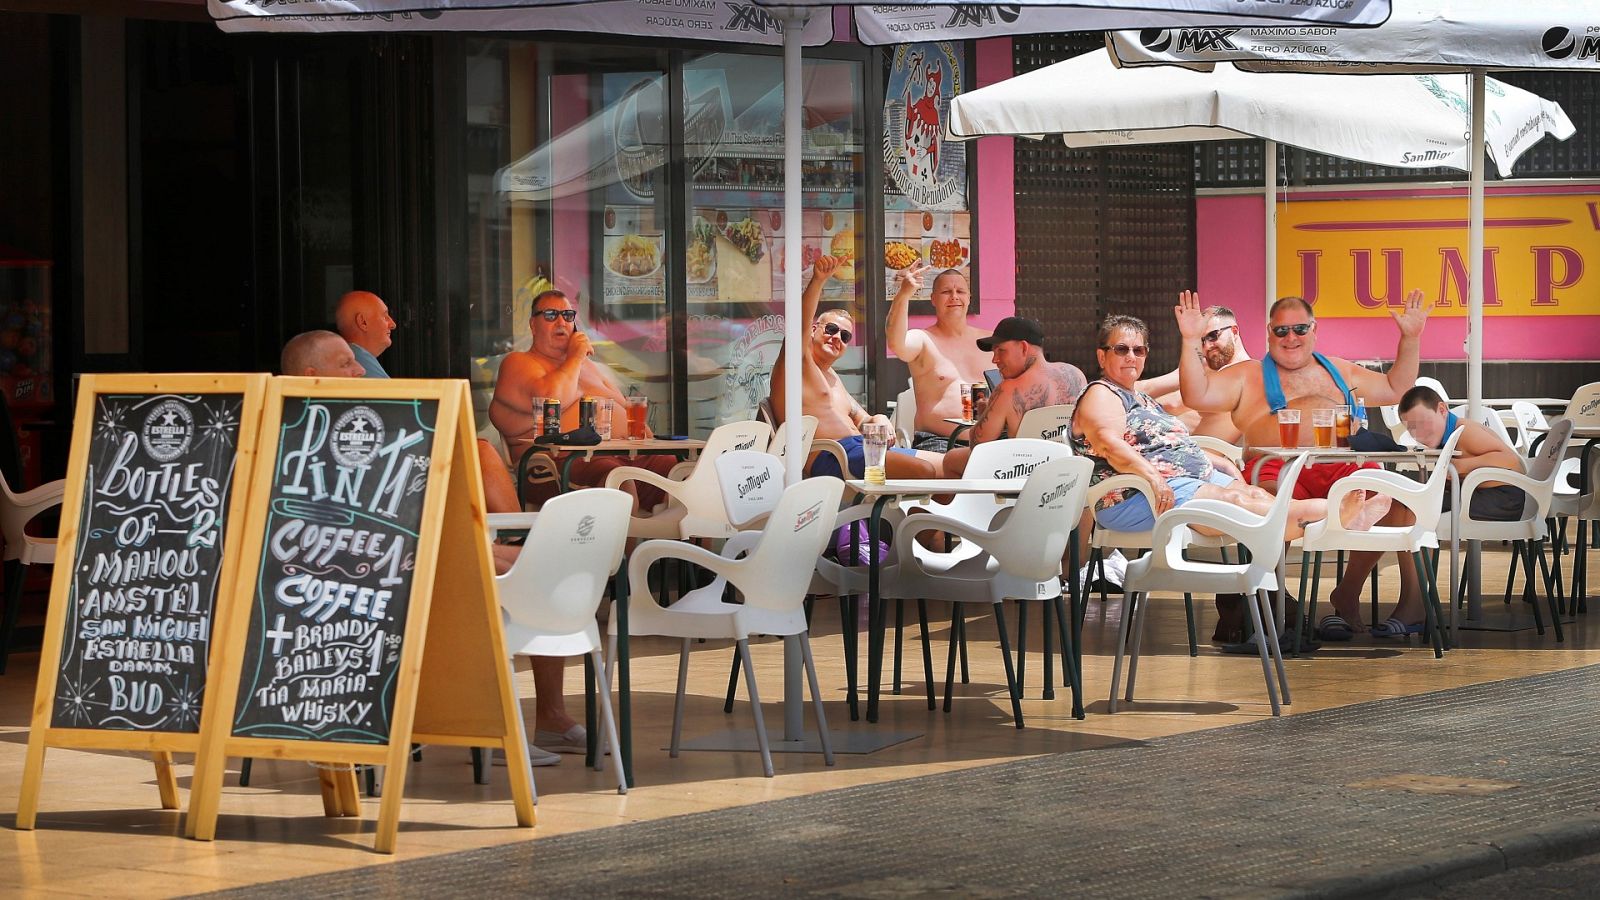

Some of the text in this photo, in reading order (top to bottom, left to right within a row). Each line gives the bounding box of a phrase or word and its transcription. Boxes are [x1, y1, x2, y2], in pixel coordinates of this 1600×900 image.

[1176, 28, 1241, 54] MAX
[1300, 28, 1337, 36] SABOR
[1250, 45, 1280, 53] ZERO
[921, 177, 958, 206] Benidorm
[1297, 245, 1585, 310] JUMP
[97, 431, 219, 508] BOTTLES
[115, 515, 158, 548] OF
[80, 617, 127, 640] SAN
[290, 619, 379, 655] BRANDY
[84, 638, 195, 663] ESTRELLA
[108, 675, 164, 713] BUD
